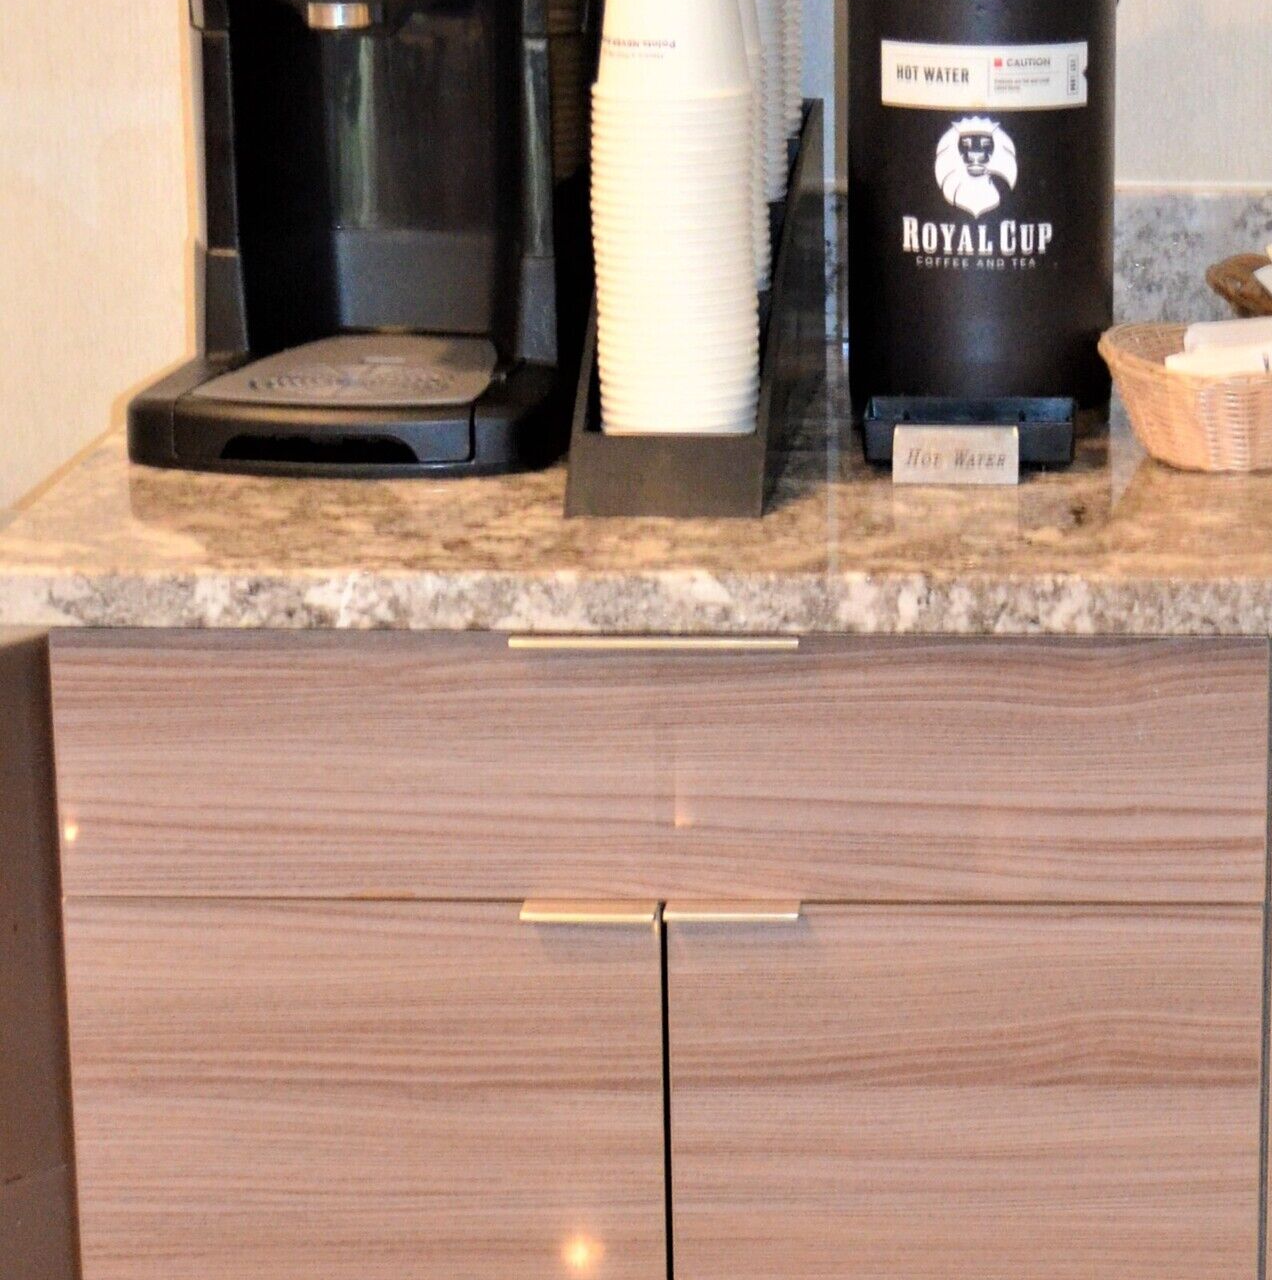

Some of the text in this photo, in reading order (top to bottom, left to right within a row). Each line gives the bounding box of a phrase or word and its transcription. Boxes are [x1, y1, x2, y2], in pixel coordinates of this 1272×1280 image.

[1006, 57, 1051, 68] CAUTION
[896, 63, 970, 84] HOT WATER
[902, 216, 1053, 256] ROYAL CUP
[915, 256, 1036, 269] COFFEE AND TEA
